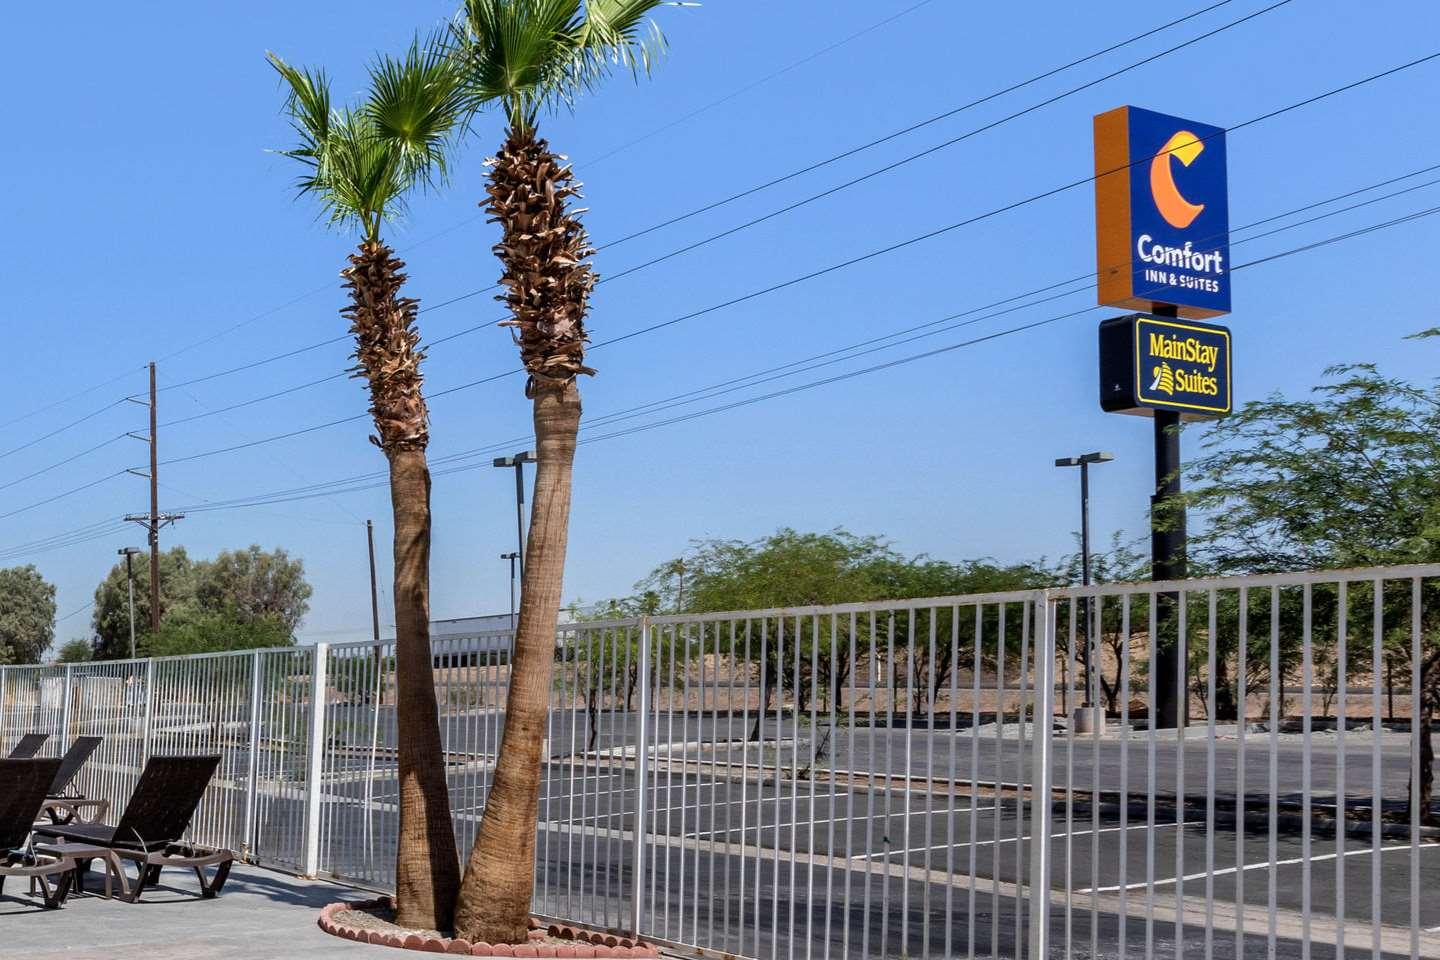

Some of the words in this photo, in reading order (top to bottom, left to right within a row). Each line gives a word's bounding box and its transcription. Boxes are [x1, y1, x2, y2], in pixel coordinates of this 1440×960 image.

[1137, 234, 1223, 275] Comfort
[1145, 269, 1167, 284] INN
[1168, 273, 1178, 286] &
[1179, 274, 1219, 293] SUITES
[1149, 333, 1219, 373] MainStay
[1175, 369, 1218, 396] Suites
